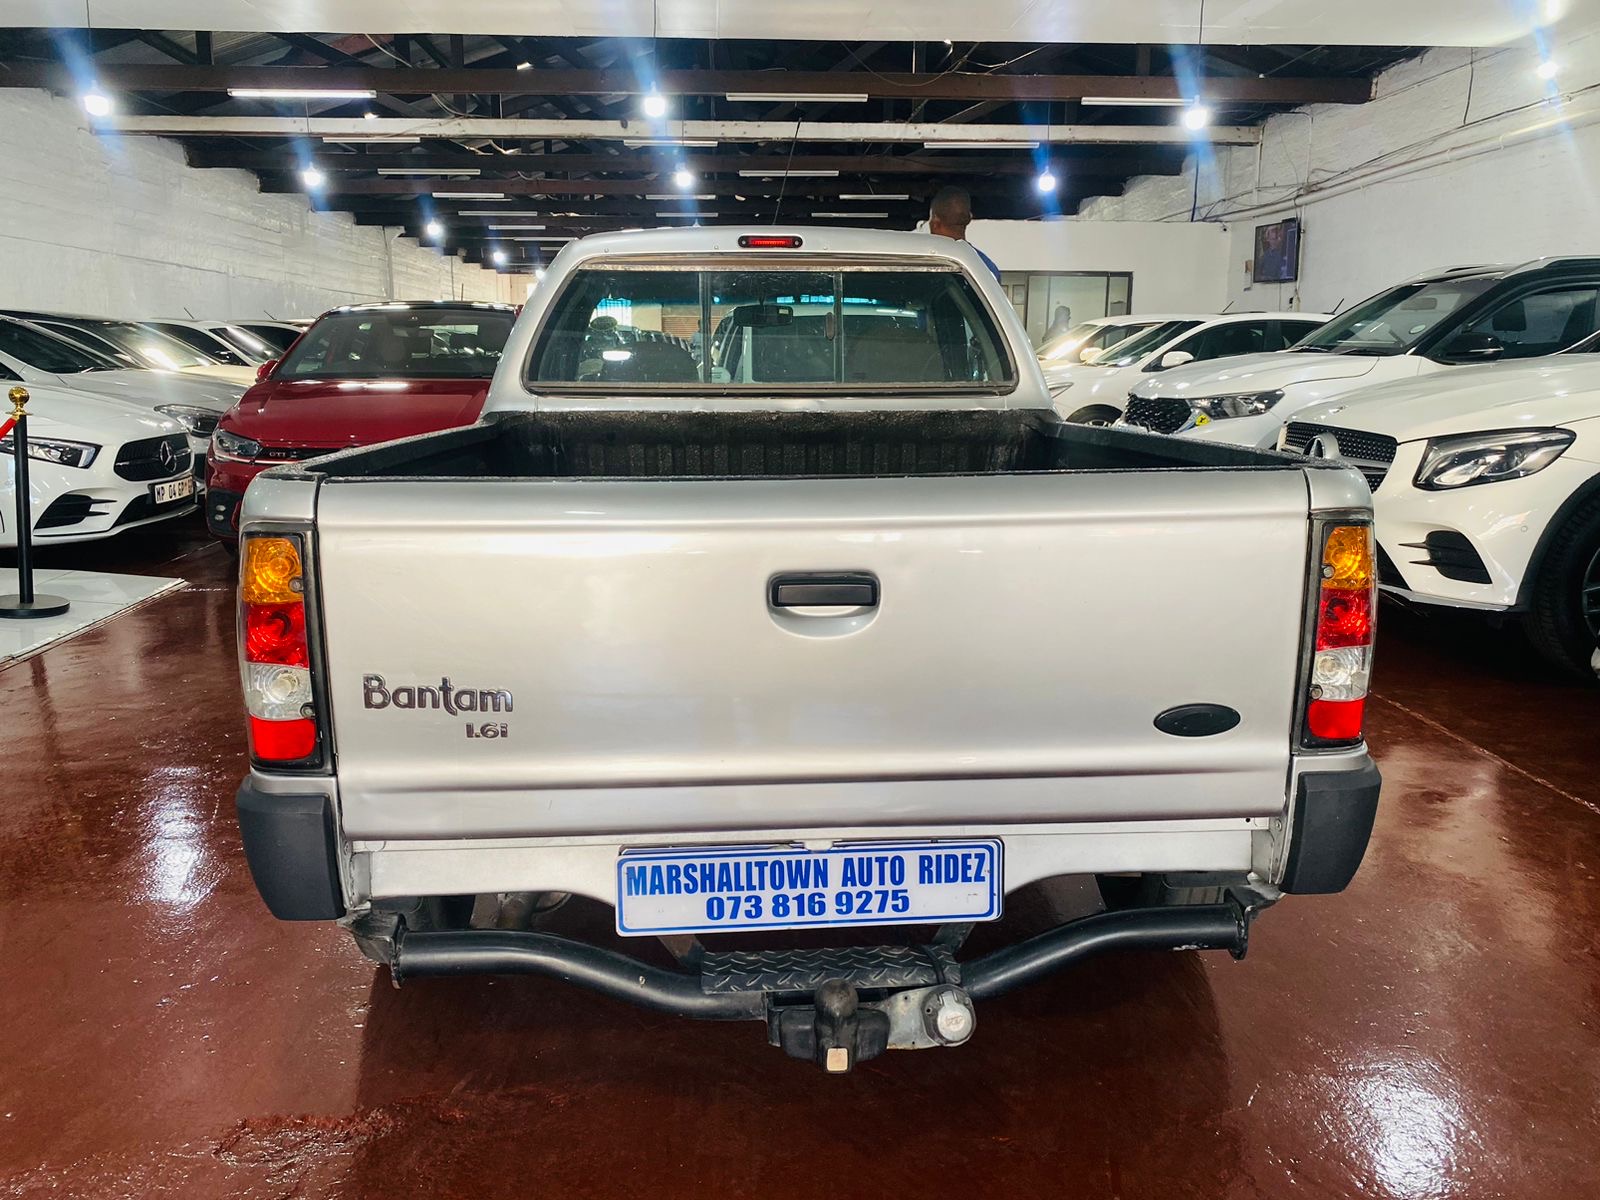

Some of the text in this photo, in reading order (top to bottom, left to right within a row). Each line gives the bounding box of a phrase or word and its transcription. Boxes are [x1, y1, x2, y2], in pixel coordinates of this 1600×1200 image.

[363, 673, 514, 716] Bantam
[465, 722, 508, 738] 1.6i
[626, 852, 986, 896] MARSHALLTOWN AUTO RIDEZ
[706, 889, 910, 921] 073 816 9275
